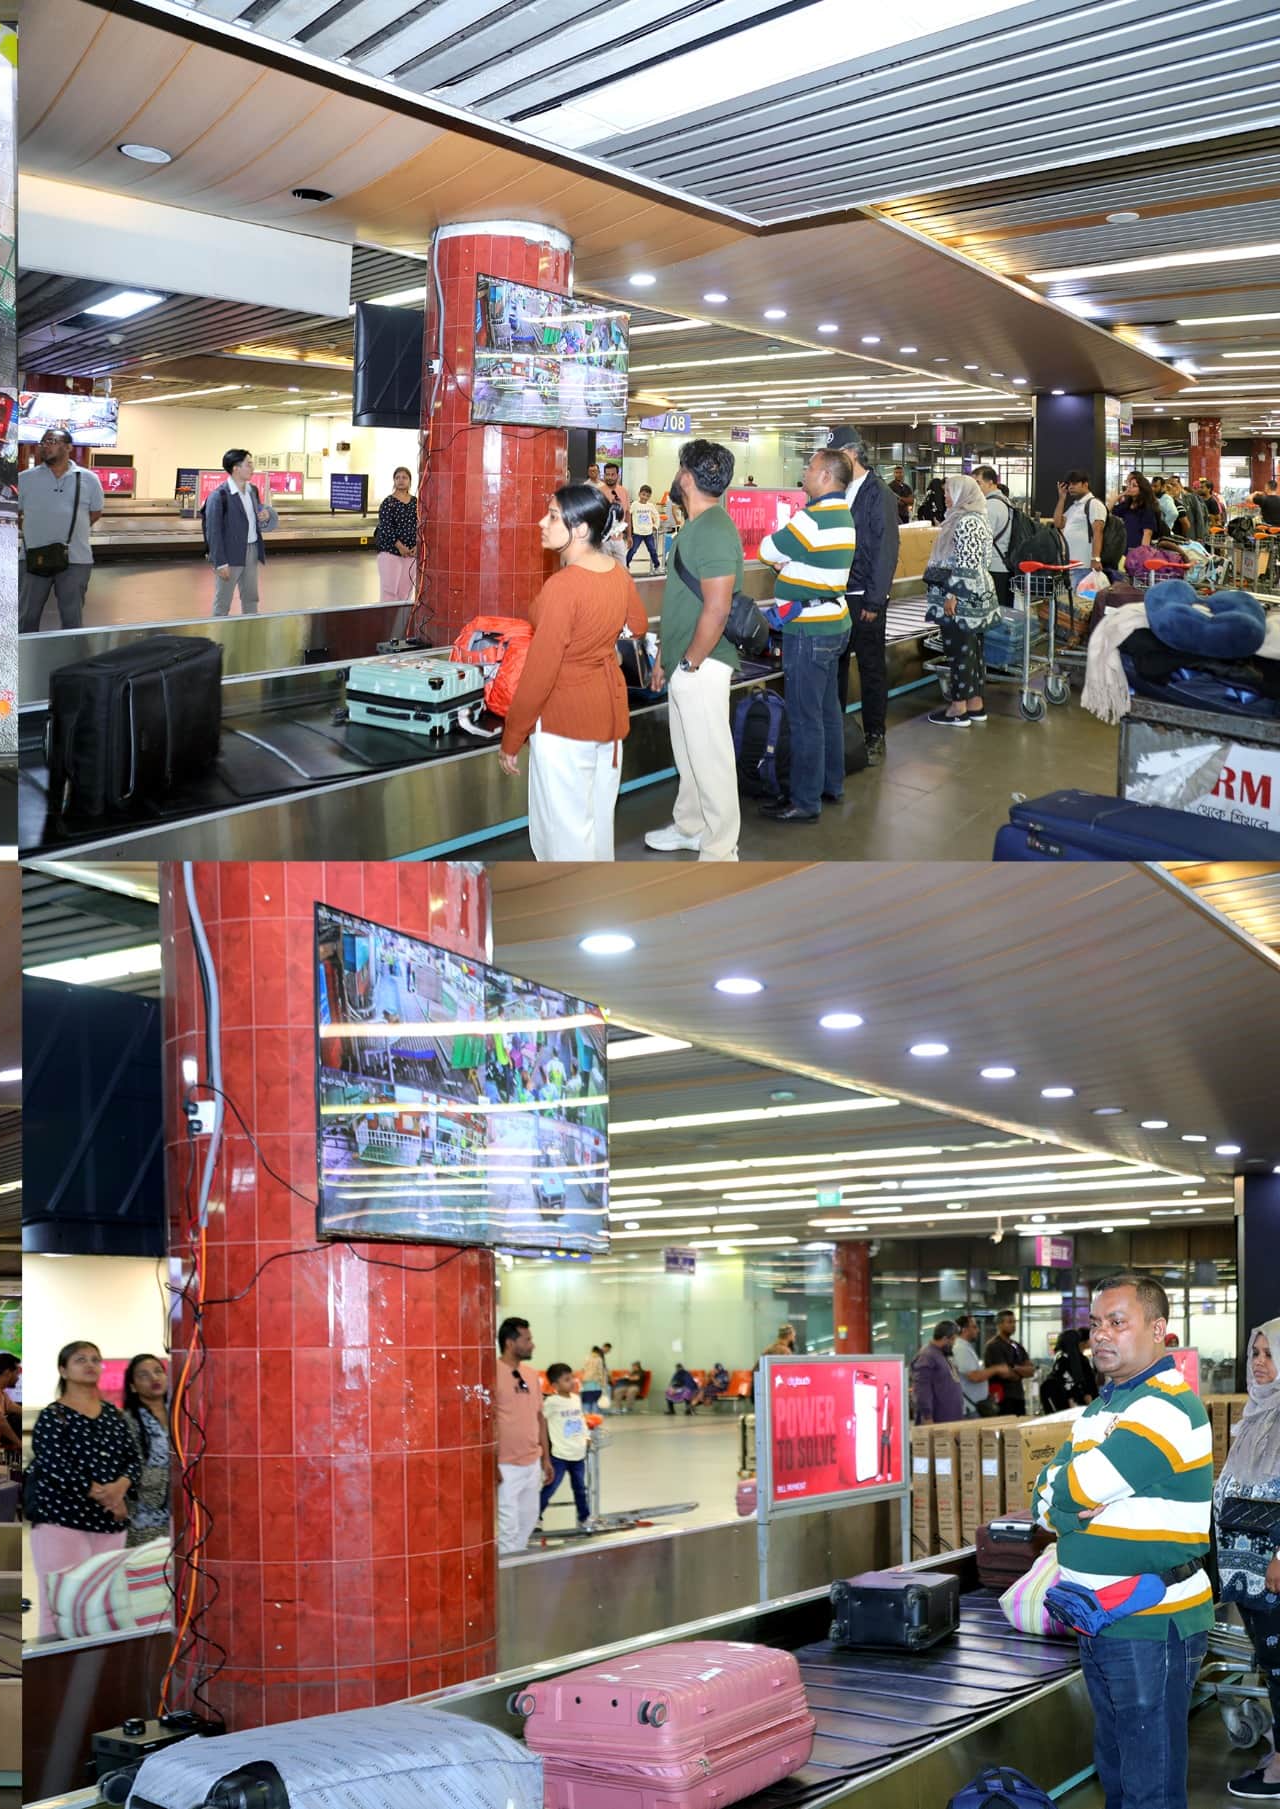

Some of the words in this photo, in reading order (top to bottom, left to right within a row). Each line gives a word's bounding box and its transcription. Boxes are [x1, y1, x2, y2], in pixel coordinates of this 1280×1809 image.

[775, 1395, 836, 1438] POWER
[777, 1438, 794, 1471] TO
[798, 1434, 837, 1469] SOLVE
